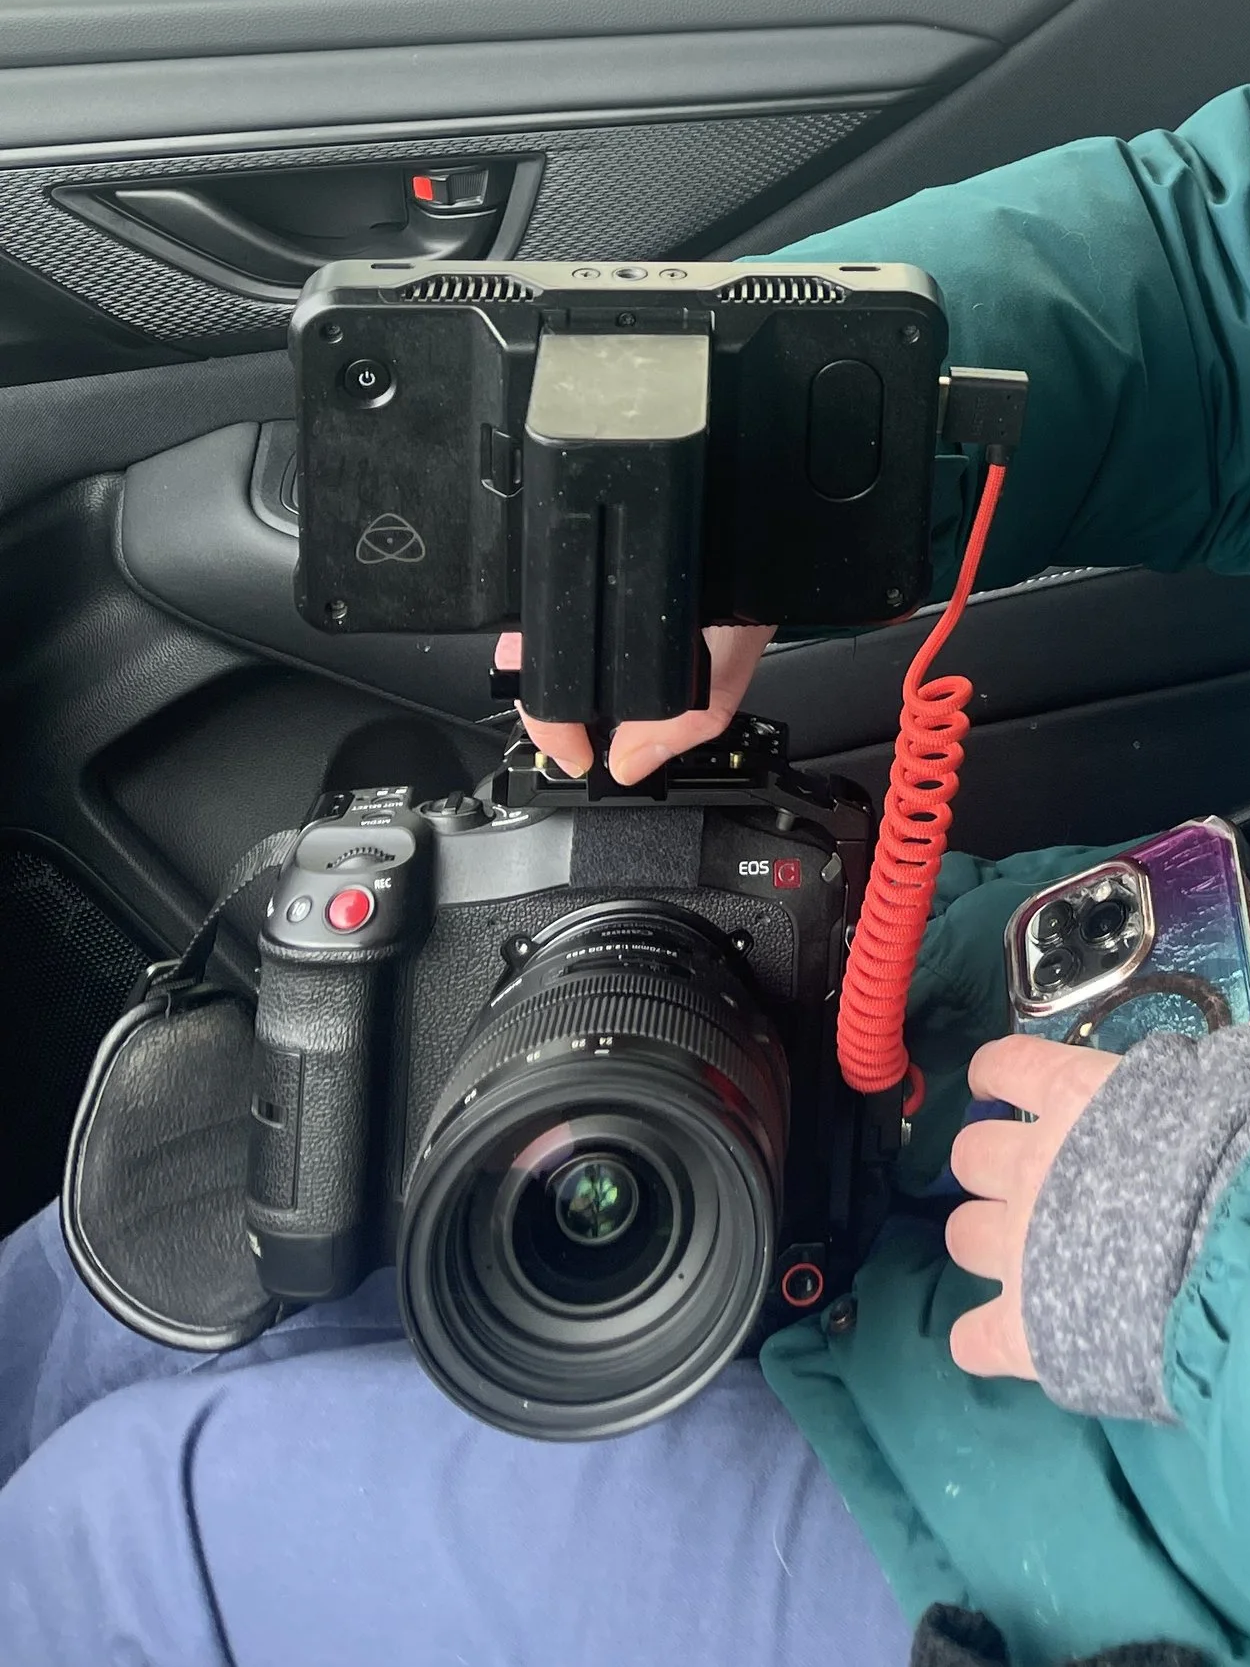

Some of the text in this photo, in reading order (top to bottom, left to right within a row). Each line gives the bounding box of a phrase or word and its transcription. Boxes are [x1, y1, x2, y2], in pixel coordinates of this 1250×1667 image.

[360, 818, 391, 826] MEDIA
[738, 860, 795, 882] EOS C
[374, 877, 392, 890] REC
[291, 900, 306, 915] 10
[631, 944, 678, 958] 24-70mm
[598, 1036, 613, 1046] 24
